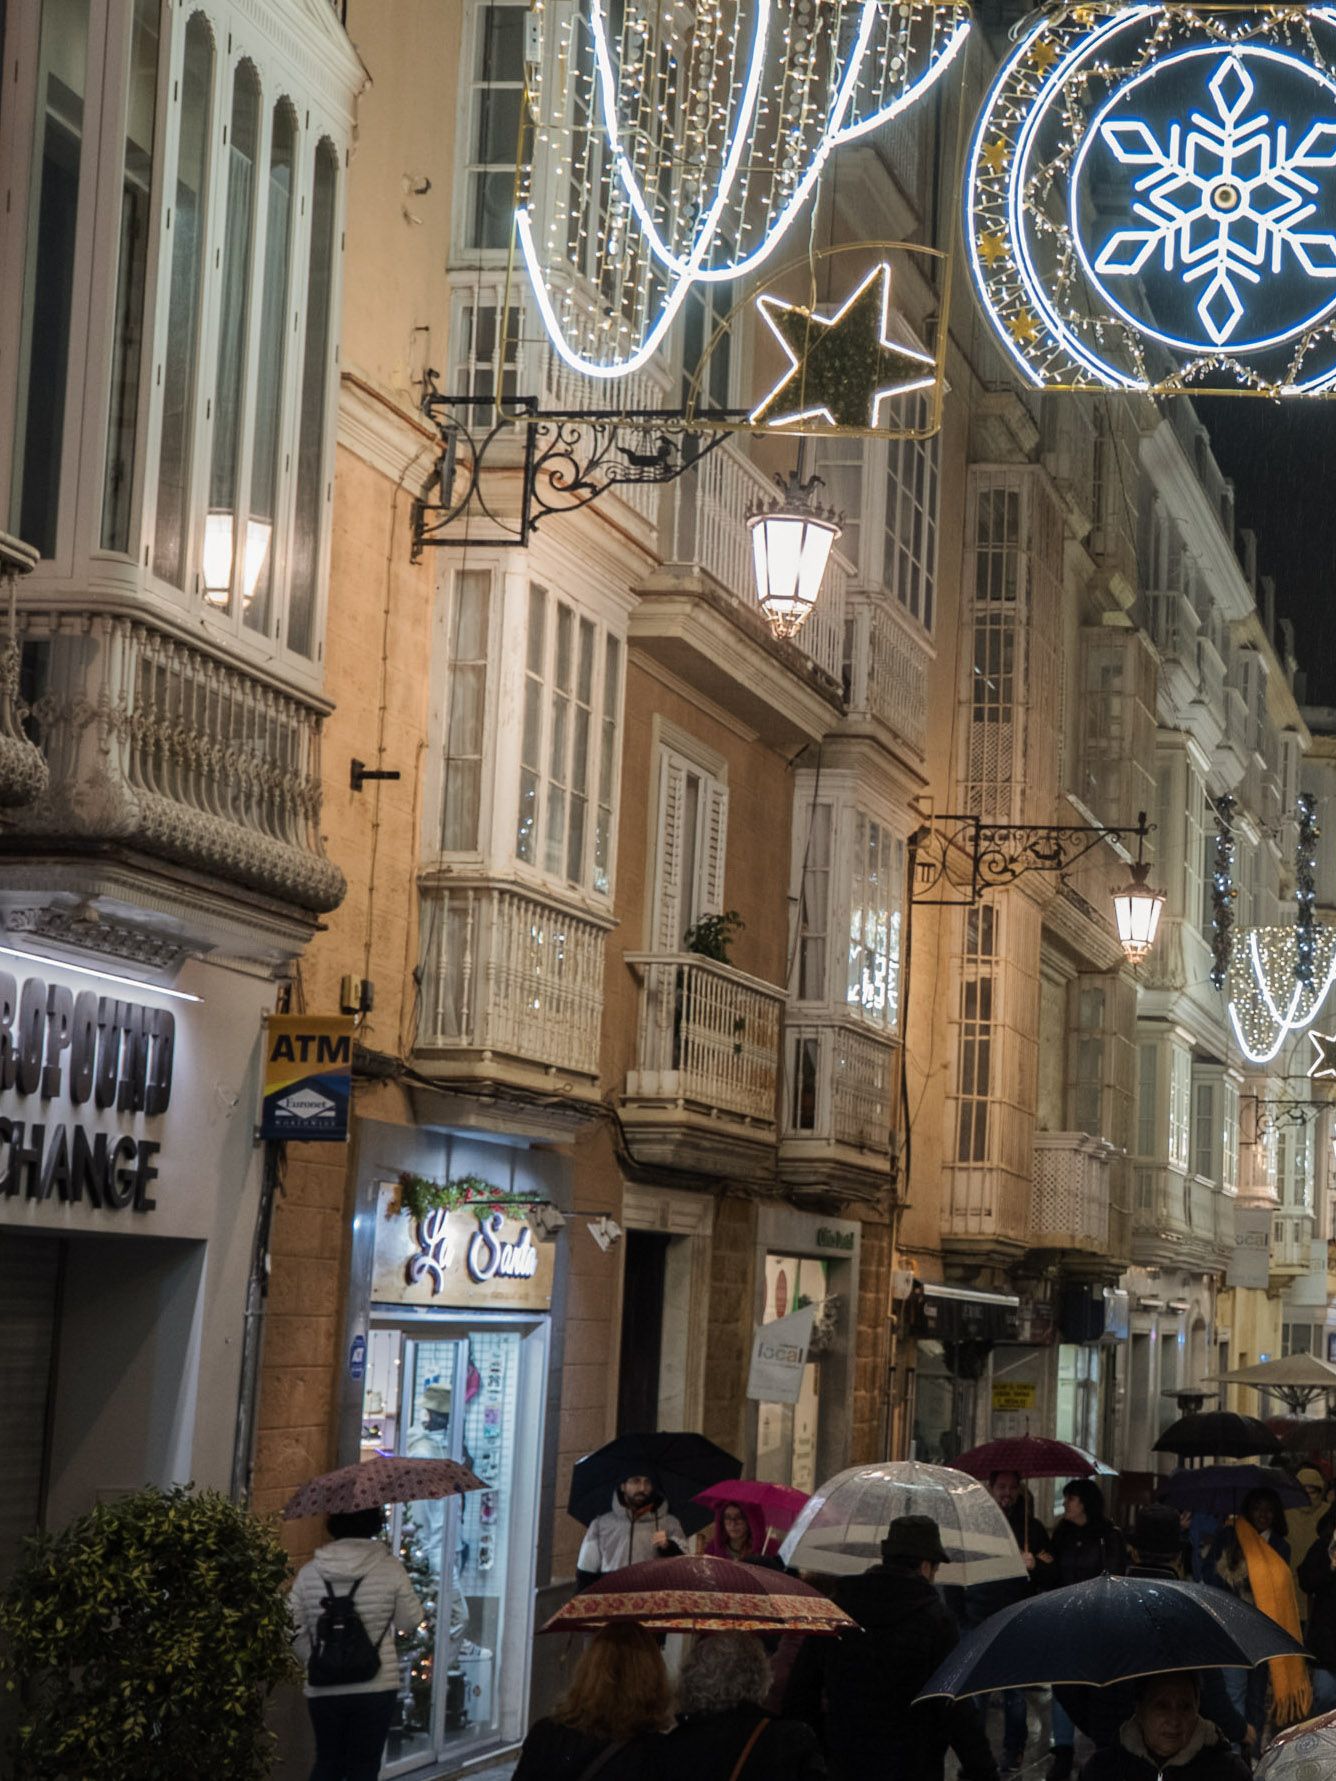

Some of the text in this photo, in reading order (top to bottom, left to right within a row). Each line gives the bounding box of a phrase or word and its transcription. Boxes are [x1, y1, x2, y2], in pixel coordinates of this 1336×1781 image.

[270, 1034, 351, 1063] ATM
[286, 1098, 326, 1108] Euronet
[467, 1213, 537, 1284] Santa
[1235, 1233, 1268, 1247] ocal
[758, 1342, 803, 1364] local
